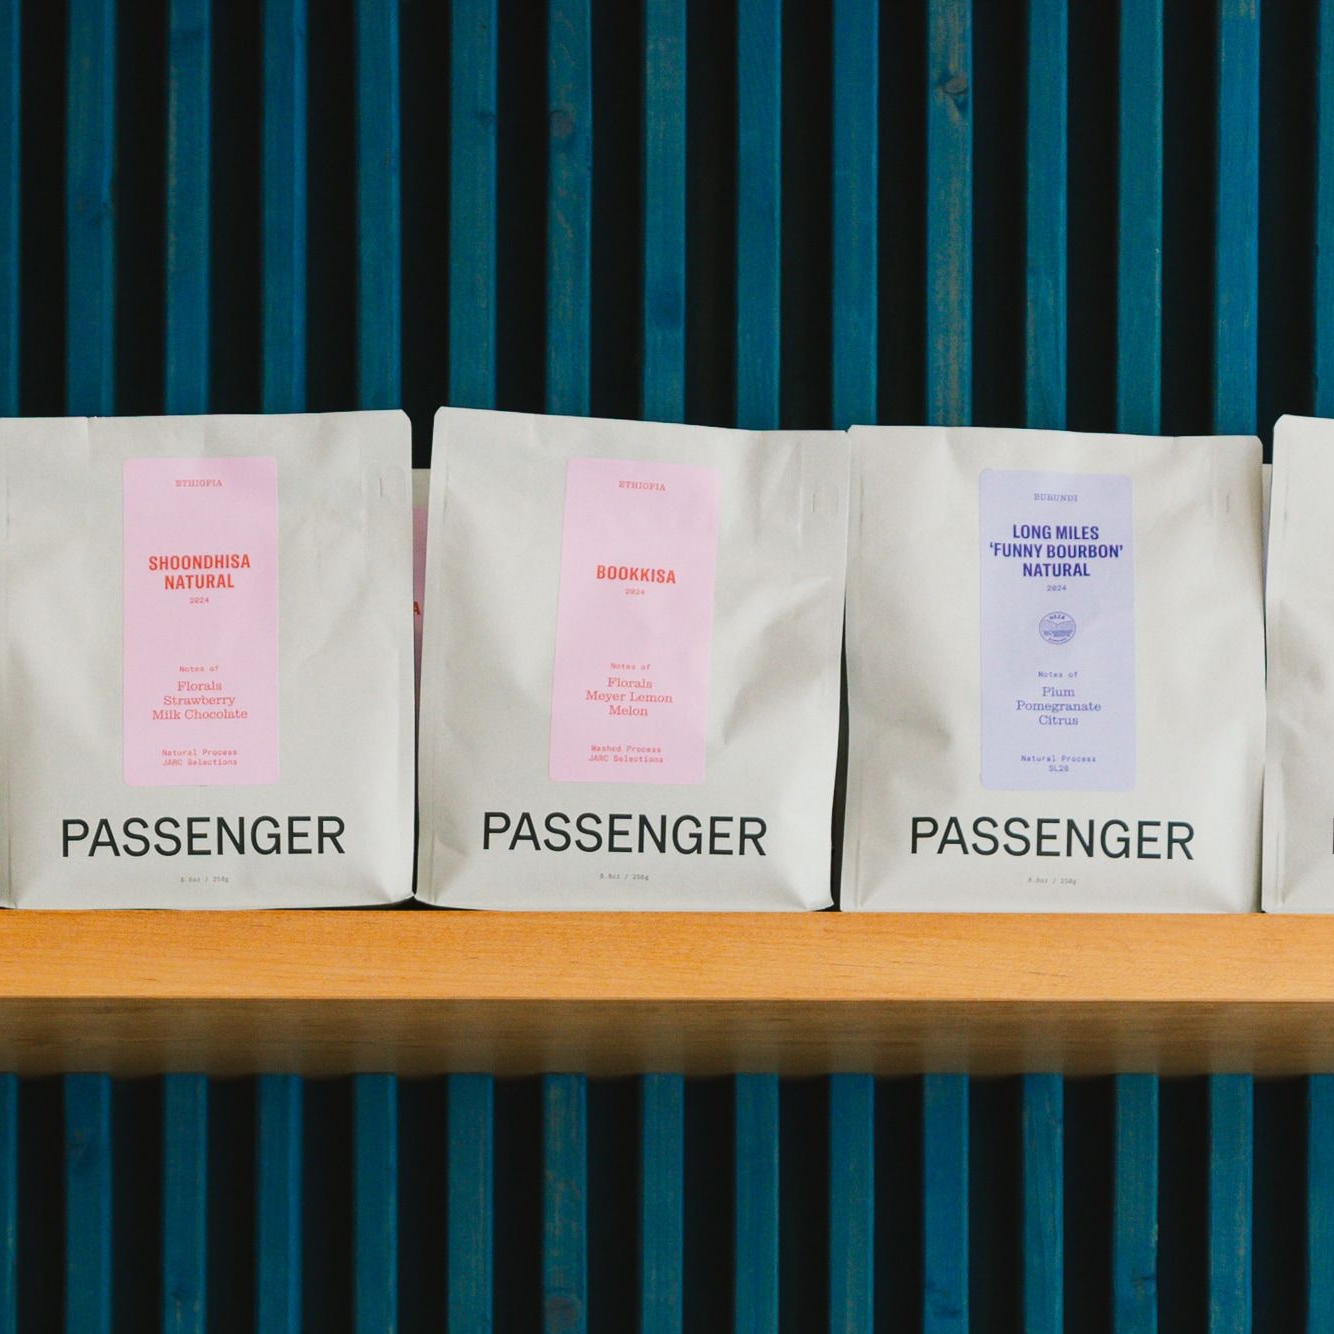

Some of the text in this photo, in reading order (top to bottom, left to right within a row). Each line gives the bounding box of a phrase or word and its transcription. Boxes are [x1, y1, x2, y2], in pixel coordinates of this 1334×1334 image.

[1012, 524, 1100, 541] LONG MILES
[148, 553, 251, 572] SHOONDHISA
[1022, 562, 1091, 578] NATURAL
[164, 573, 235, 590] NATURAL
[596, 564, 676, 585] BOOKKISA
[1046, 584, 1067, 592] 2024
[177, 680, 223, 692] Florals
[607, 676, 653, 690] Florals
[585, 689, 673, 704] Meyer Lemon
[1042, 685, 1076, 698] Plum
[163, 694, 236, 708] Strawberry
[1016, 699, 1102, 714] Pomegranate
[152, 708, 248, 721] Milk Chocolate
[608, 704, 649, 717] Melon
[1038, 714, 1079, 726] Citrus
[62, 815, 346, 858] PASSENGER
[482, 811, 767, 857] PASSENGER
[910, 816, 1195, 861] PASSENGER
